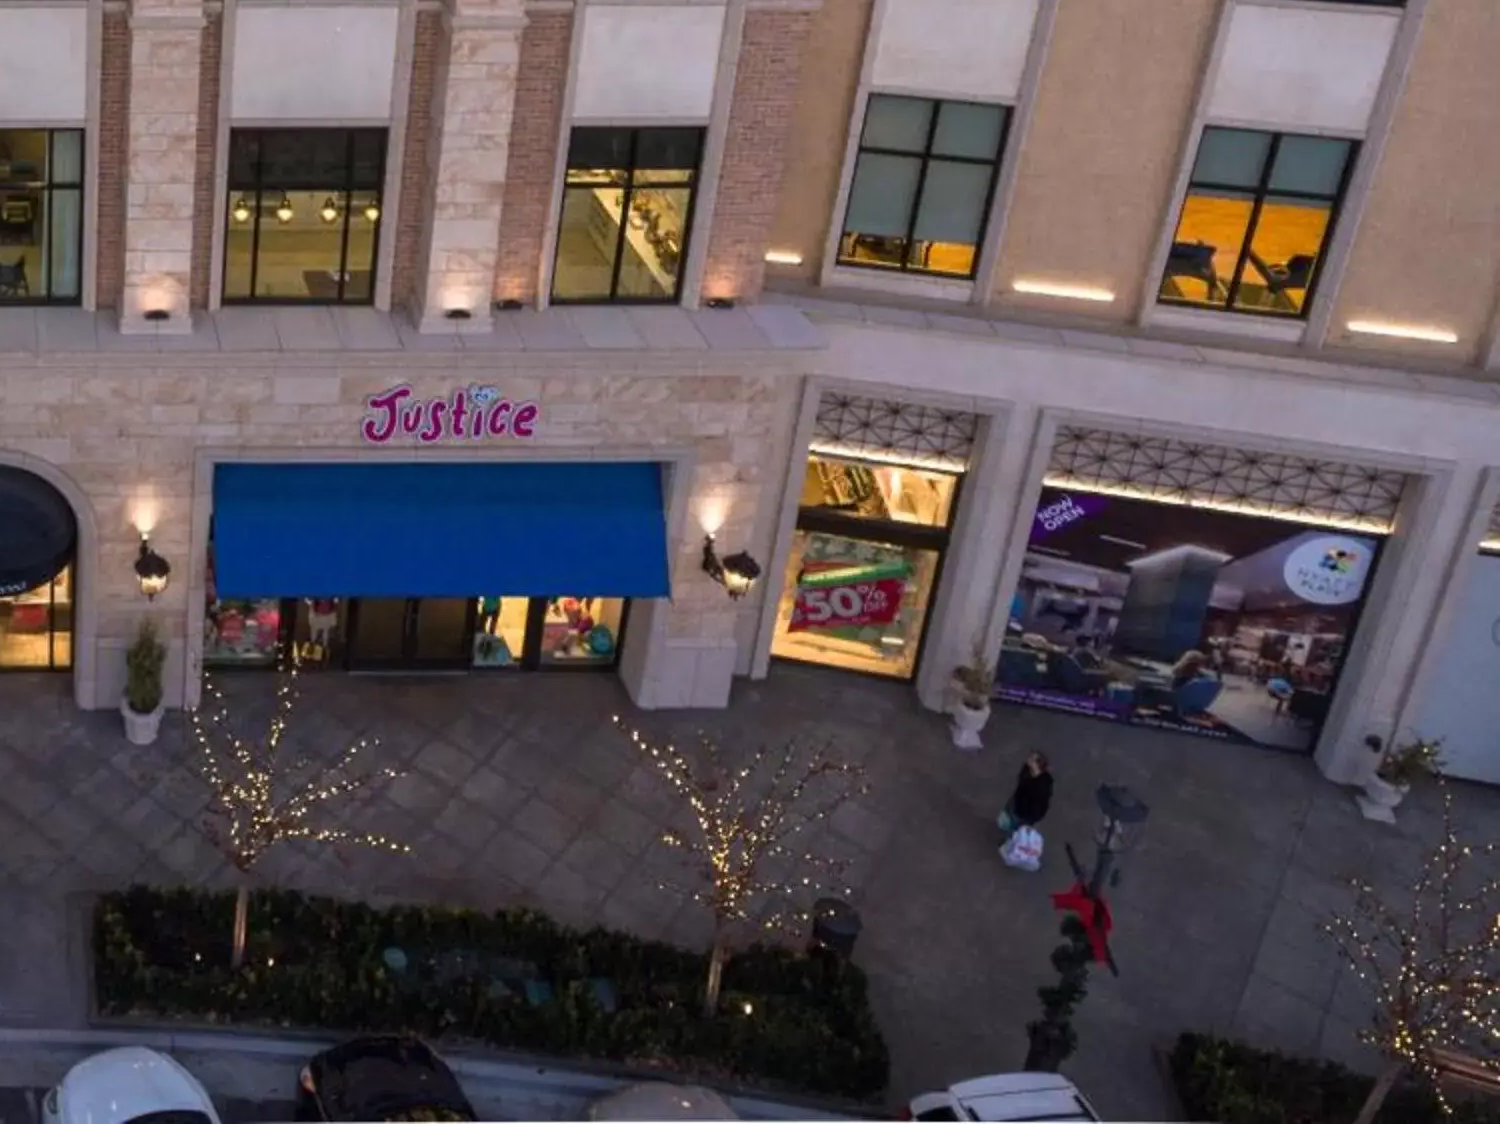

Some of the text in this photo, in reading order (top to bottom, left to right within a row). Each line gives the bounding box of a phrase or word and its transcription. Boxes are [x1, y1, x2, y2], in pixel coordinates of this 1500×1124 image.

[363, 385, 539, 444] Justice
[1037, 495, 1073, 523] NOW
[1043, 504, 1085, 531] OPEN
